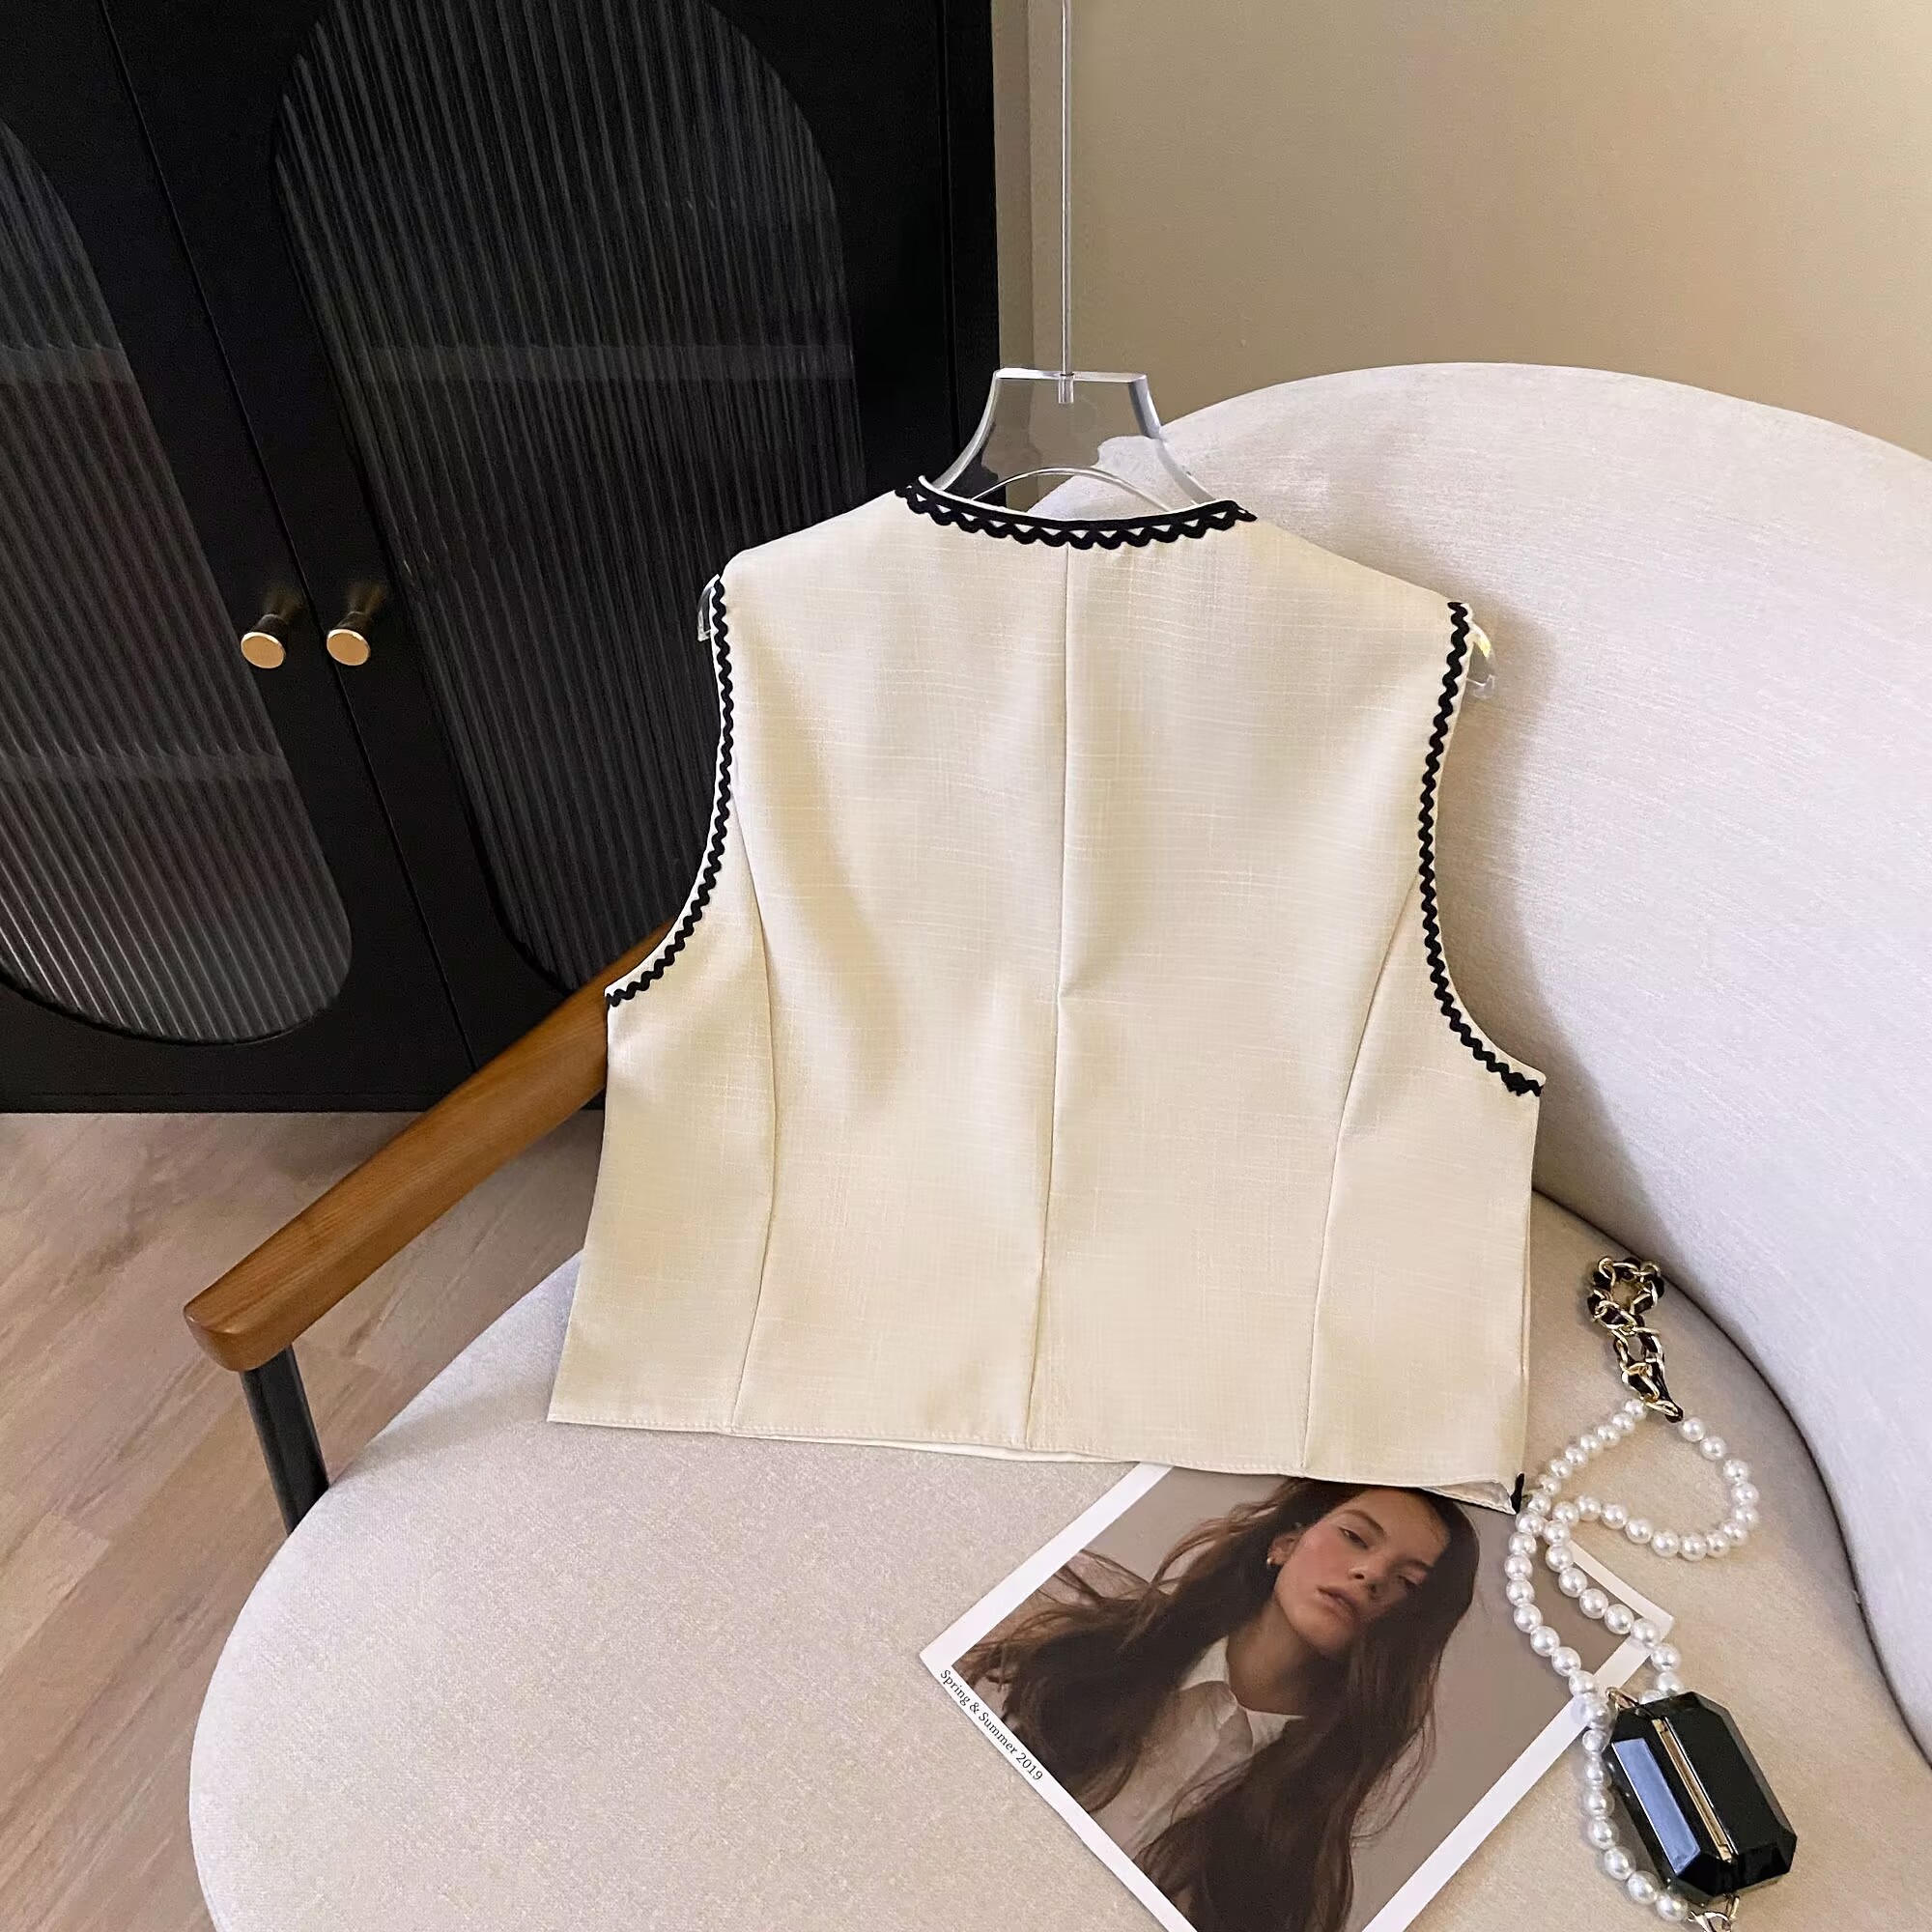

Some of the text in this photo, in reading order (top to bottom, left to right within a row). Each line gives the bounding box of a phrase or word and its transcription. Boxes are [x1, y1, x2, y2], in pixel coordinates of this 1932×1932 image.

[940, 1669, 1043, 1780] Spring & Summer 2019
